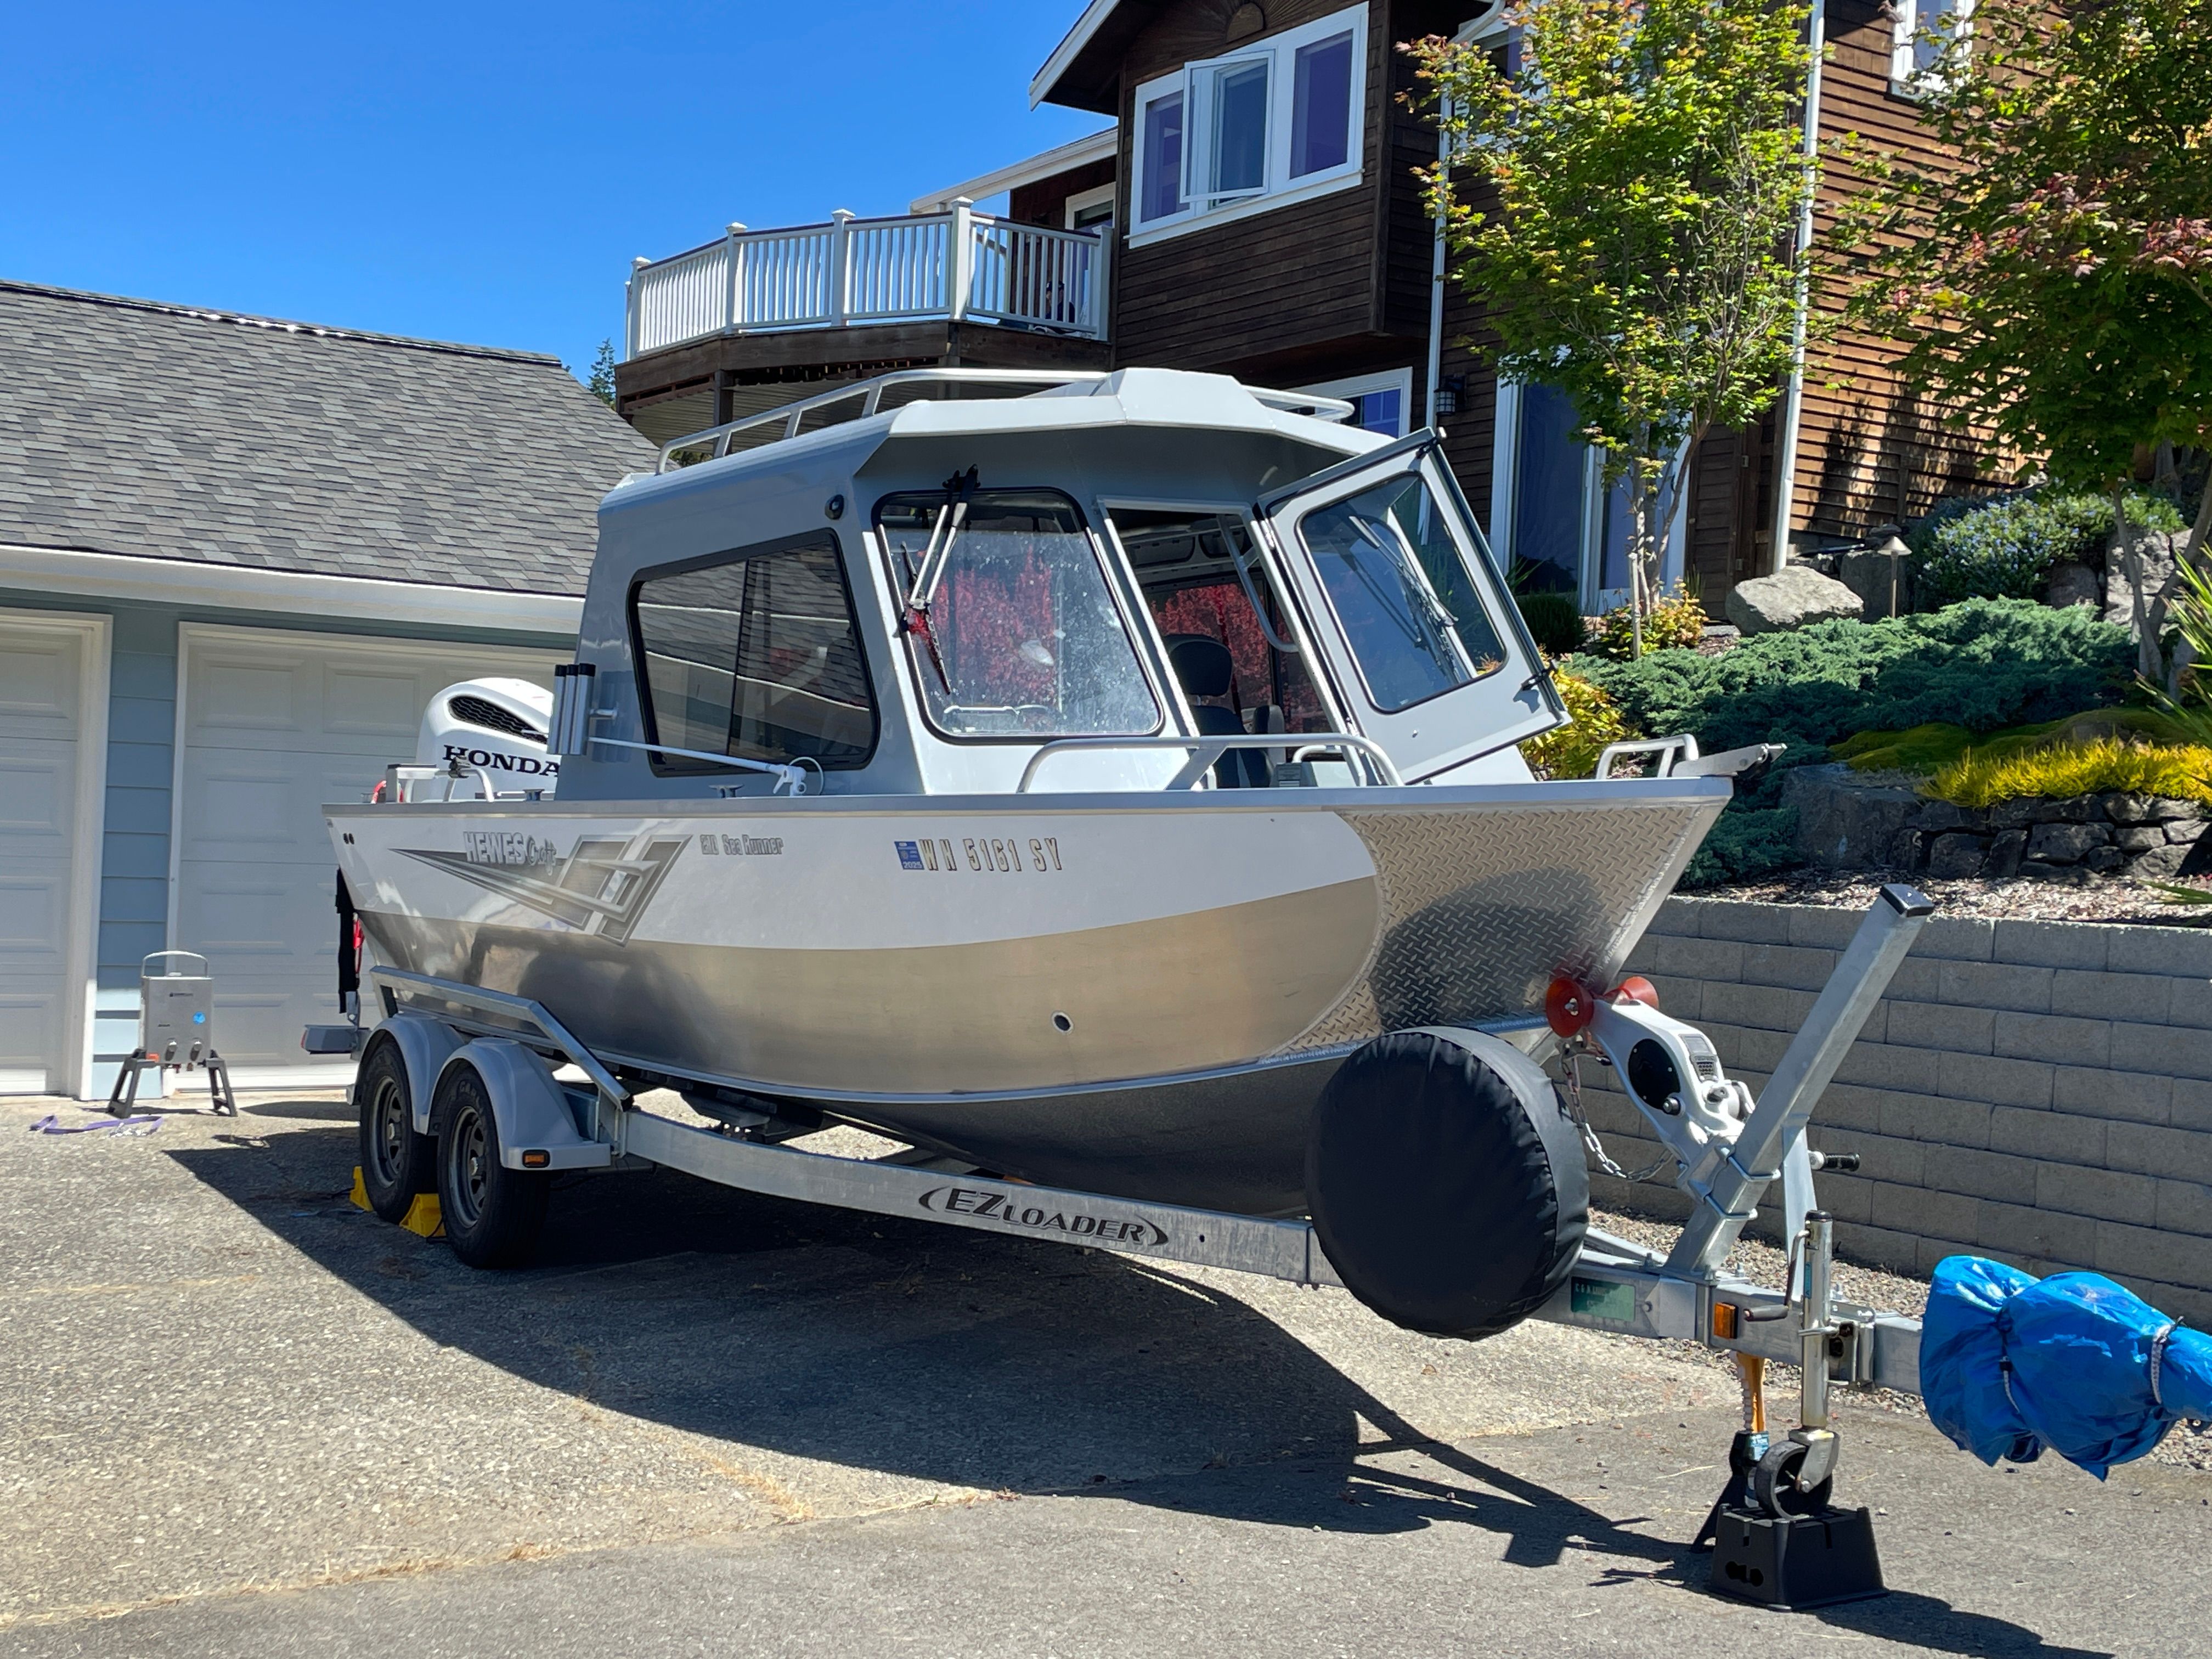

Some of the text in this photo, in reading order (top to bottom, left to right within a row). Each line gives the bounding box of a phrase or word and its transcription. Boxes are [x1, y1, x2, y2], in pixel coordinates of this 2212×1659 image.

[442, 744, 560, 777] HONDA
[721, 834, 743, 855] Sea
[742, 834, 784, 855] Runner
[962, 838, 1022, 871] 5161
[1029, 838, 1062, 871] SY
